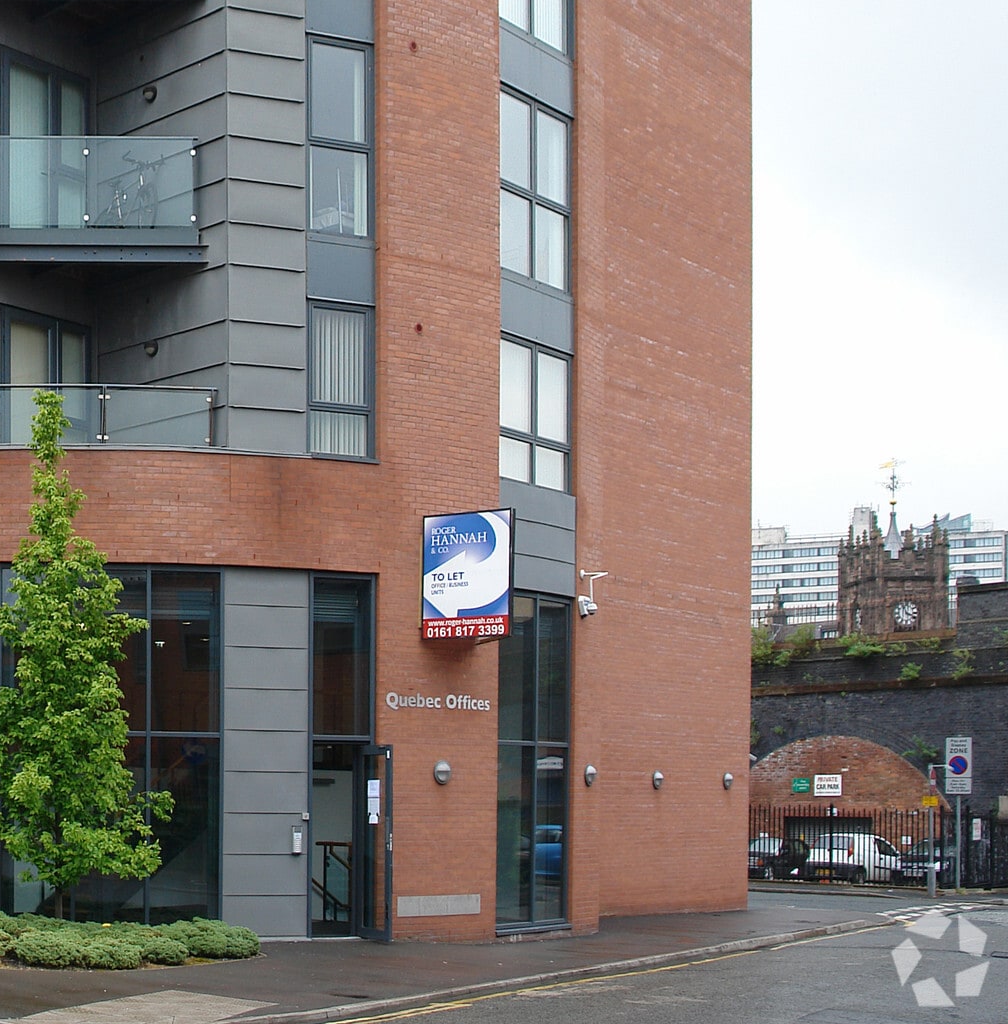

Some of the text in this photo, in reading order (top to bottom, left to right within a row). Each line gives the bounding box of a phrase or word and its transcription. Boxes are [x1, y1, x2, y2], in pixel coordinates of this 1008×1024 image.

[431, 526, 457, 536] ROGER
[431, 531, 487, 547] HANNAH
[430, 547, 436, 555] &
[432, 571, 465, 582] TO LET
[428, 617, 504, 627] www.roger-hannah.co.uk
[427, 624, 505, 638] 0161 817 3399
[385, 691, 491, 711] Quebec Offices
